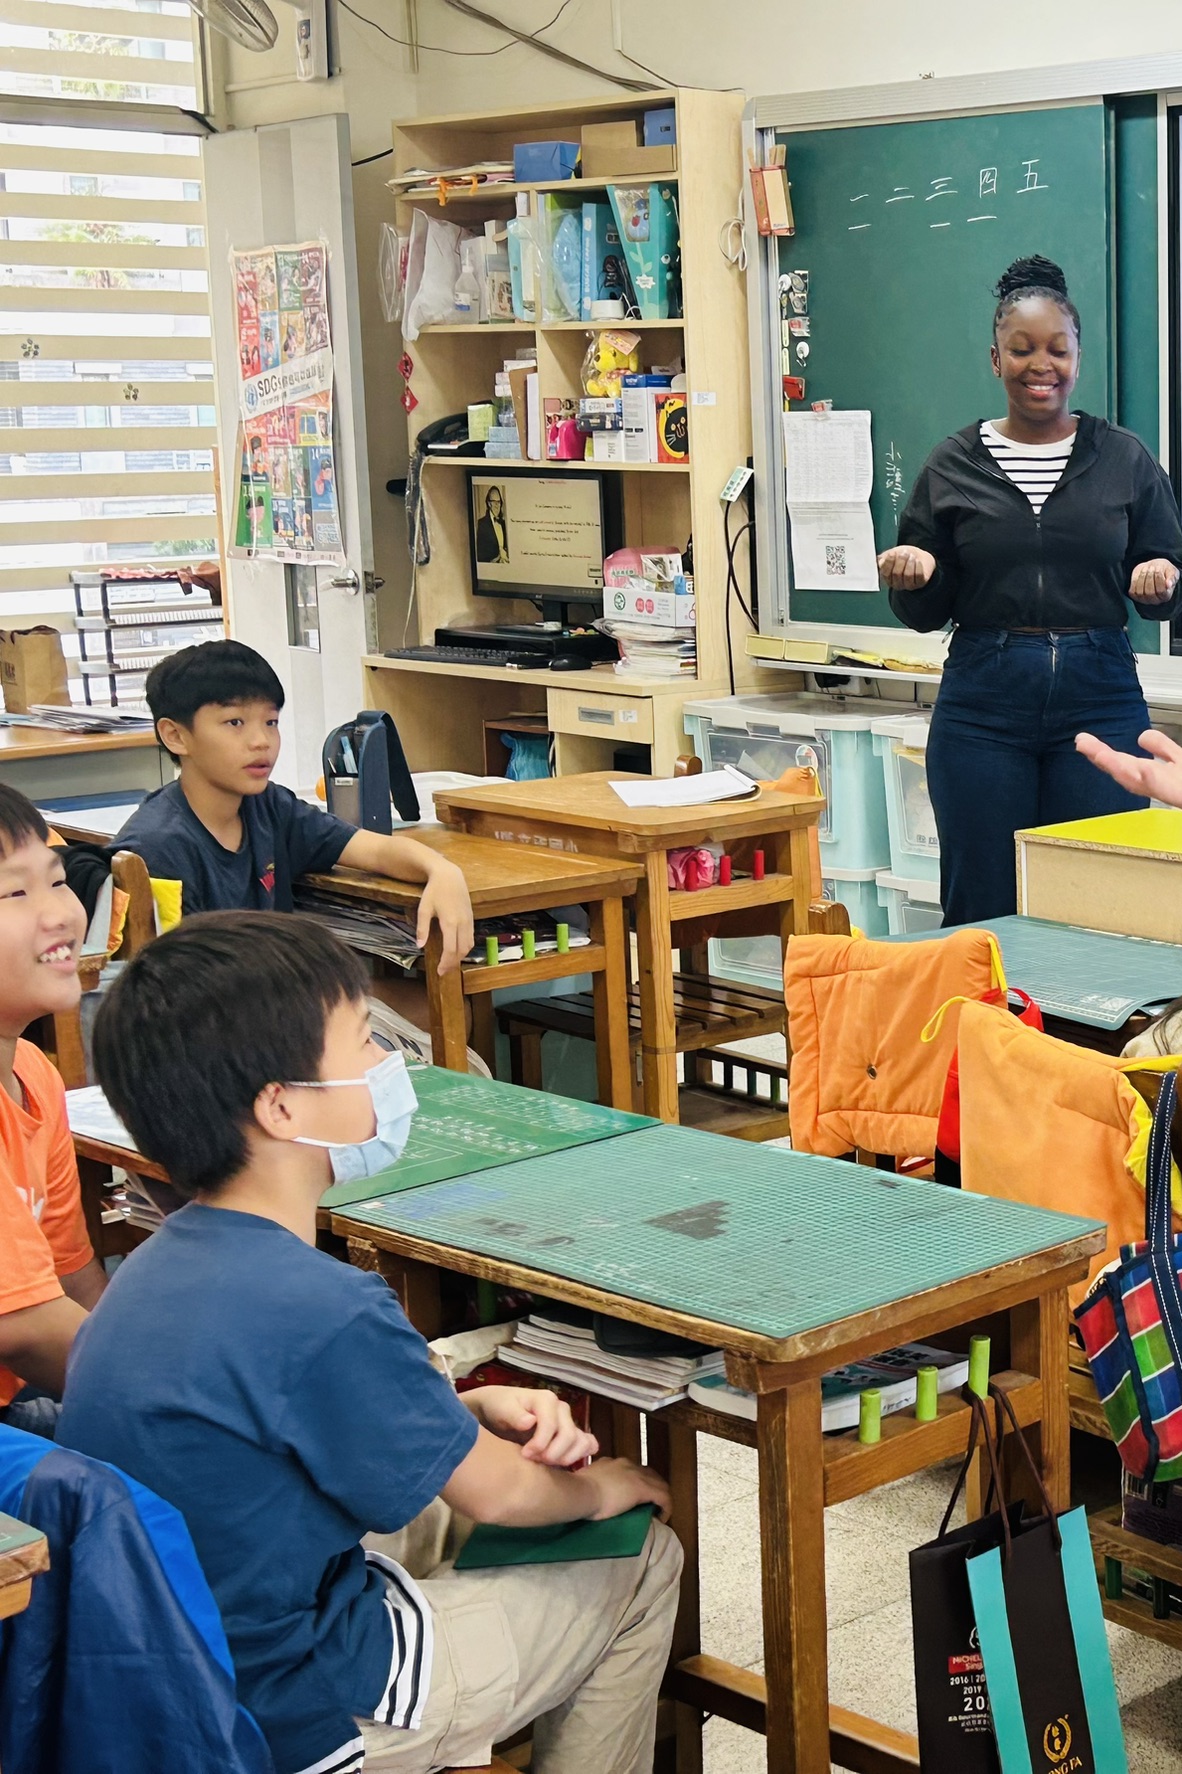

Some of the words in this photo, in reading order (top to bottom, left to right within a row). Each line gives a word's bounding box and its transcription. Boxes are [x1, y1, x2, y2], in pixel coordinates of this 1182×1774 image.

[885, 187, 915, 203] 二
[925, 176, 958, 201] 三
[1016, 158, 1049, 194] 五
